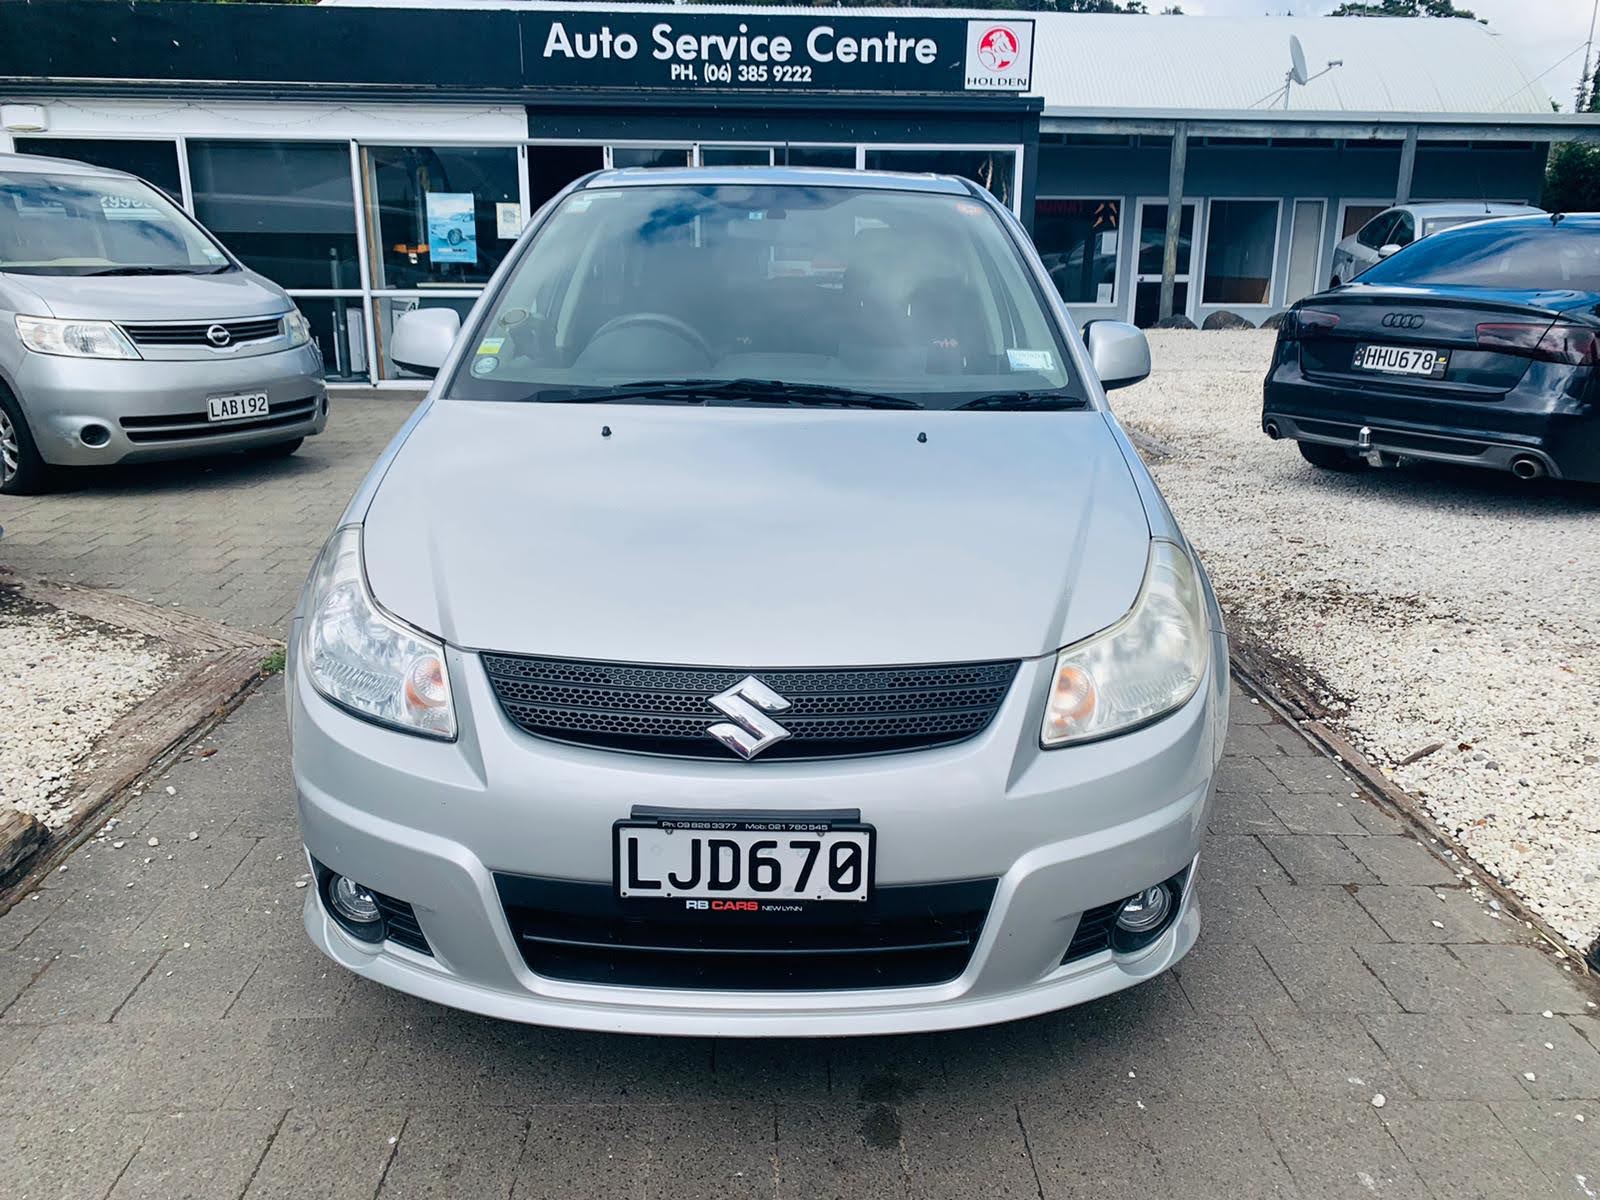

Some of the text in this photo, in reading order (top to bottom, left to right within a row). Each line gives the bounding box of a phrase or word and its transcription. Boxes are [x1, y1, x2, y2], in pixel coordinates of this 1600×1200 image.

[543, 22, 938, 64] Auto Service Centre
[671, 62, 812, 83] PH. (06) 385 9222
[966, 76, 1028, 88] HOLDEN
[1365, 348, 1433, 370] HHU678
[210, 396, 266, 417] LAB192
[677, 821, 691, 829] 09
[711, 822, 738, 831] 3377
[745, 823, 767, 831] Mob:
[768, 823, 786, 831] 021
[808, 824, 829, 832] 545
[627, 837, 862, 893] LJD670
[685, 899, 709, 910] RB
[711, 900, 759, 911] CARS
